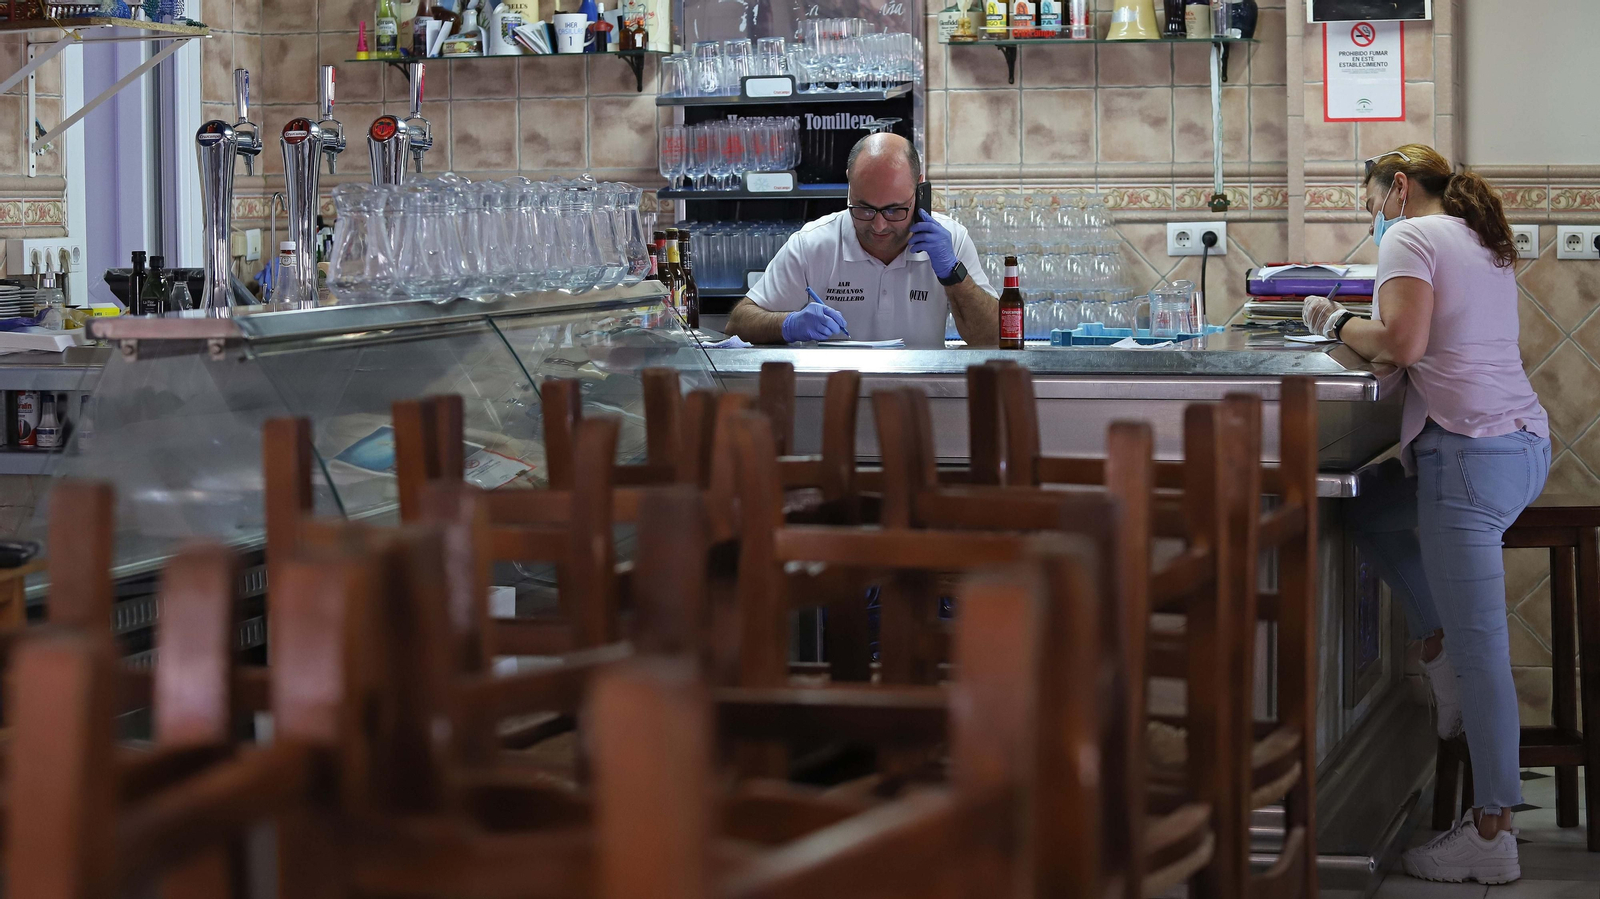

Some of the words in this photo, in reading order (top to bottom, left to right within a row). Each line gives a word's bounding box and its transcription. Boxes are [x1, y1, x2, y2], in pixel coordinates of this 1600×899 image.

[1012, 29, 1056, 38] Cruzcampo
[568, 36, 573, 46] 1
[909, 289, 929, 302] QUINI
